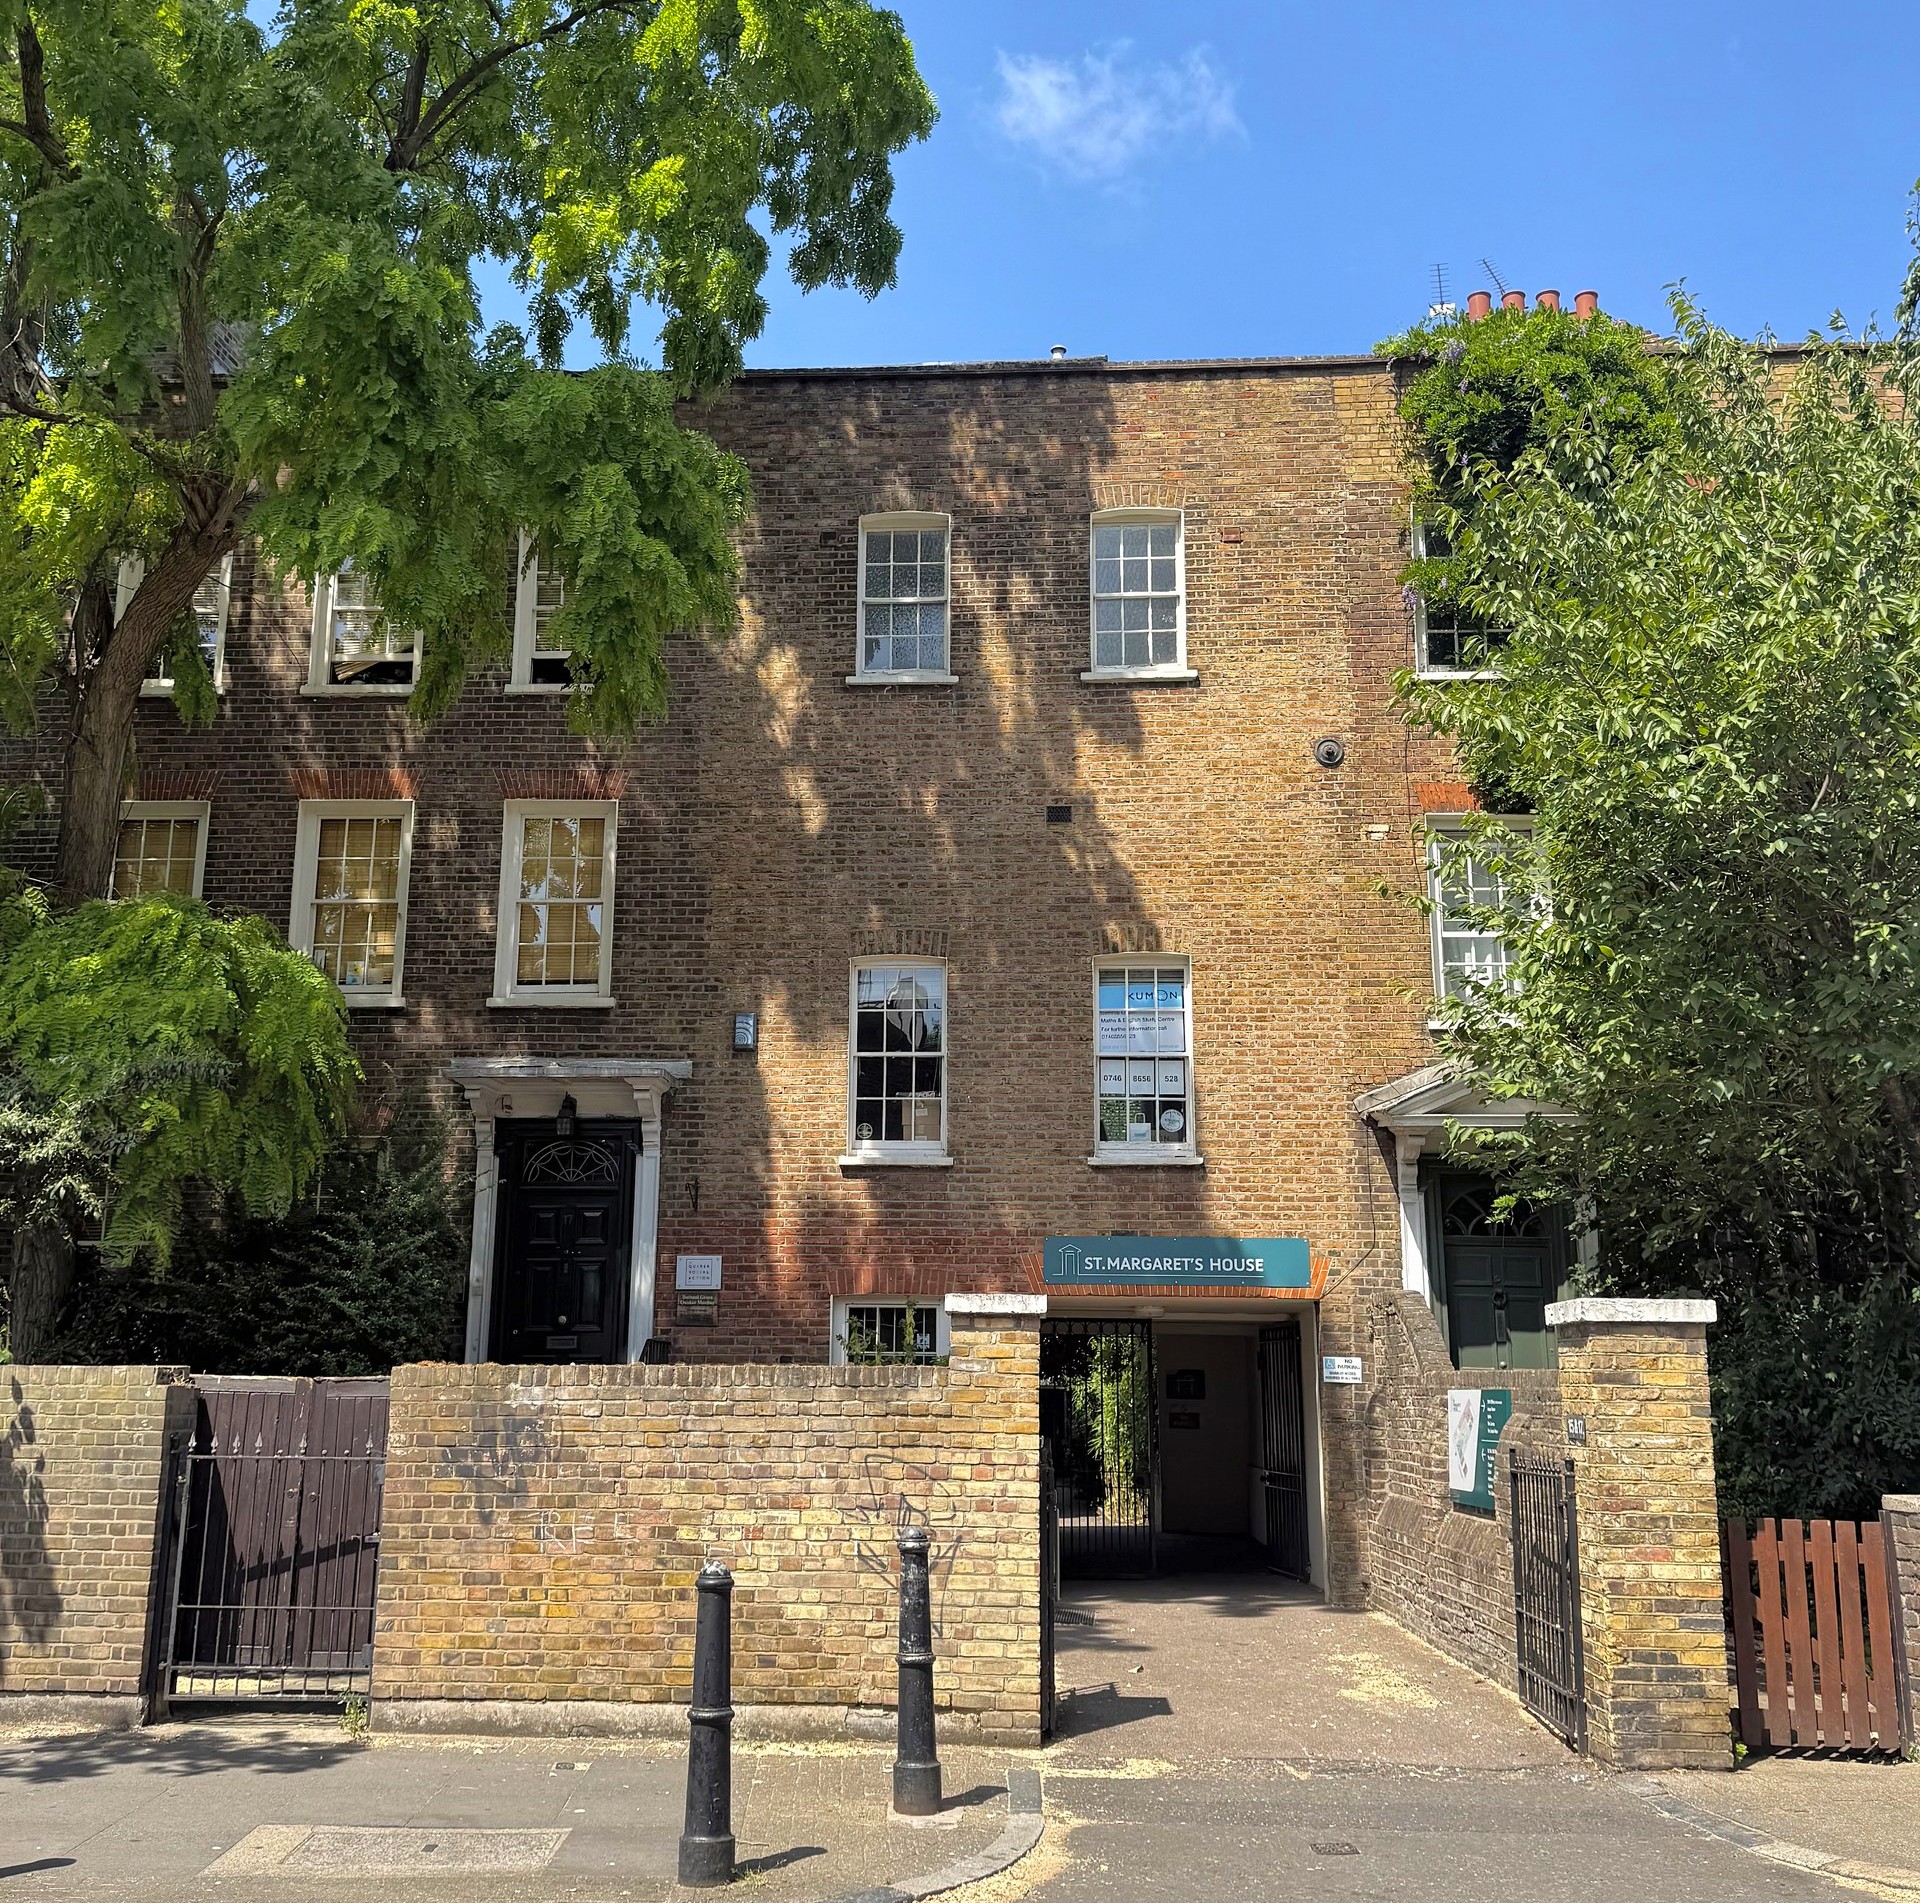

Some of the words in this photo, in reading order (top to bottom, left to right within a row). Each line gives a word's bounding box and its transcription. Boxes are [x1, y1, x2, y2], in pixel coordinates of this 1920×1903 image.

[1128, 989, 1178, 1001] KUMON
[1103, 1074, 1122, 1082] 0746
[1209, 1257, 1264, 1273] HOUSE
